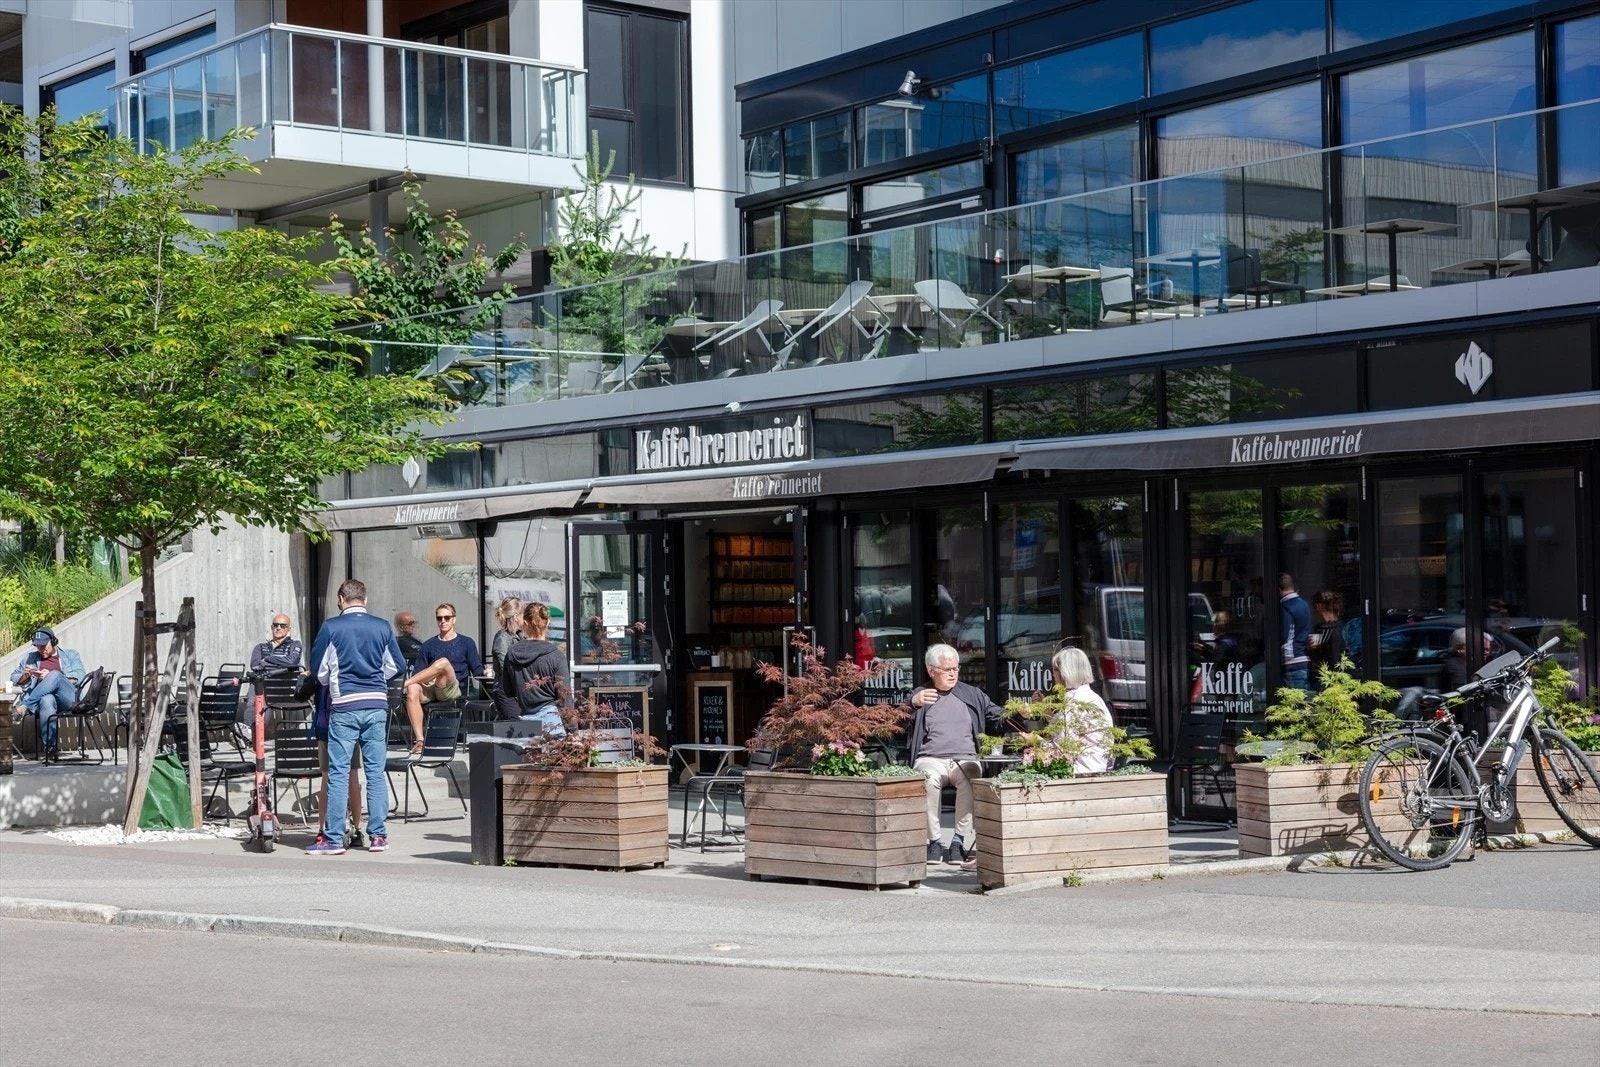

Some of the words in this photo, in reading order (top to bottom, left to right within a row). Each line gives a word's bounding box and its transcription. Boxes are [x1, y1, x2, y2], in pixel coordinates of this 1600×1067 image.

[636, 415, 805, 470] Kaffebrenneriet
[1230, 428, 1364, 463] Kaffebrenneriet
[395, 502, 459, 523] Kaffebrenneriet
[1008, 661, 1053, 691] Kaffe
[1201, 662, 1254, 695] Kaffe
